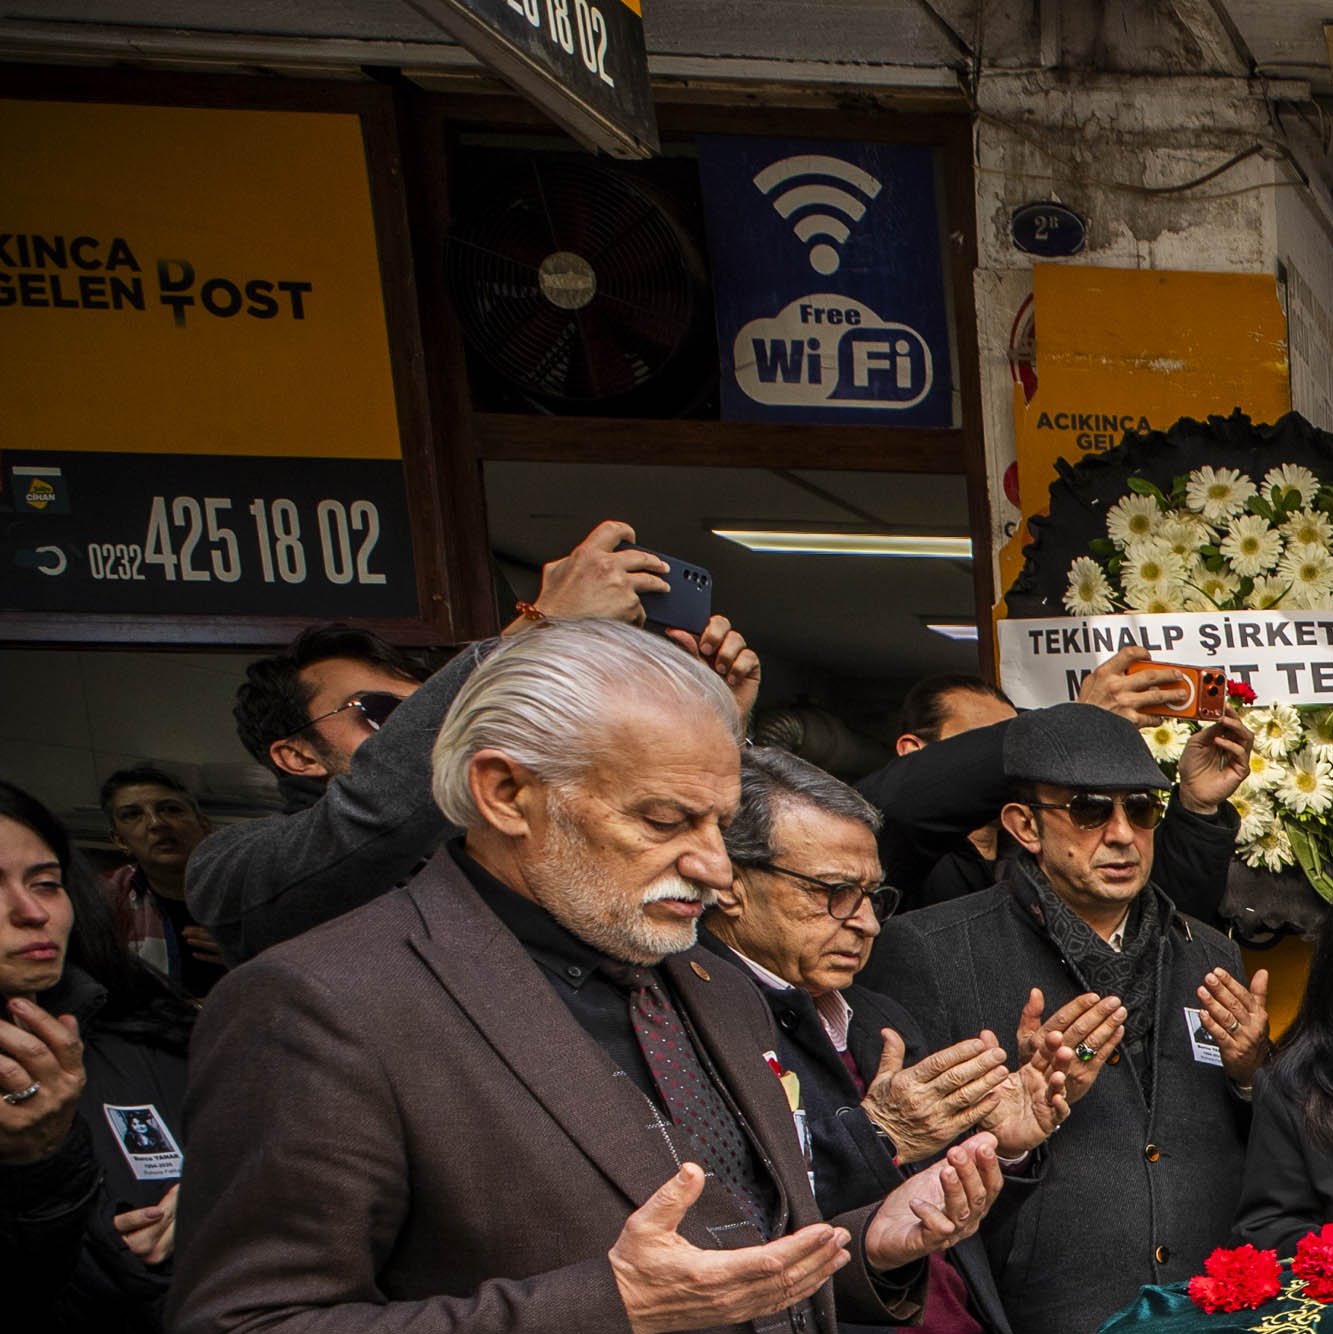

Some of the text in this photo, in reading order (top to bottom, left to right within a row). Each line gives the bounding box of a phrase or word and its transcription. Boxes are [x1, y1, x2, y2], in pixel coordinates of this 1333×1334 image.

[575, 0, 615, 88] 02
[800, 303, 861, 325] Free
[1037, 412, 1151, 432] ACIKINCA
[88, 496, 387, 585] 0232 425 18 02
[1028, 621, 1184, 655] TEKİNALP
